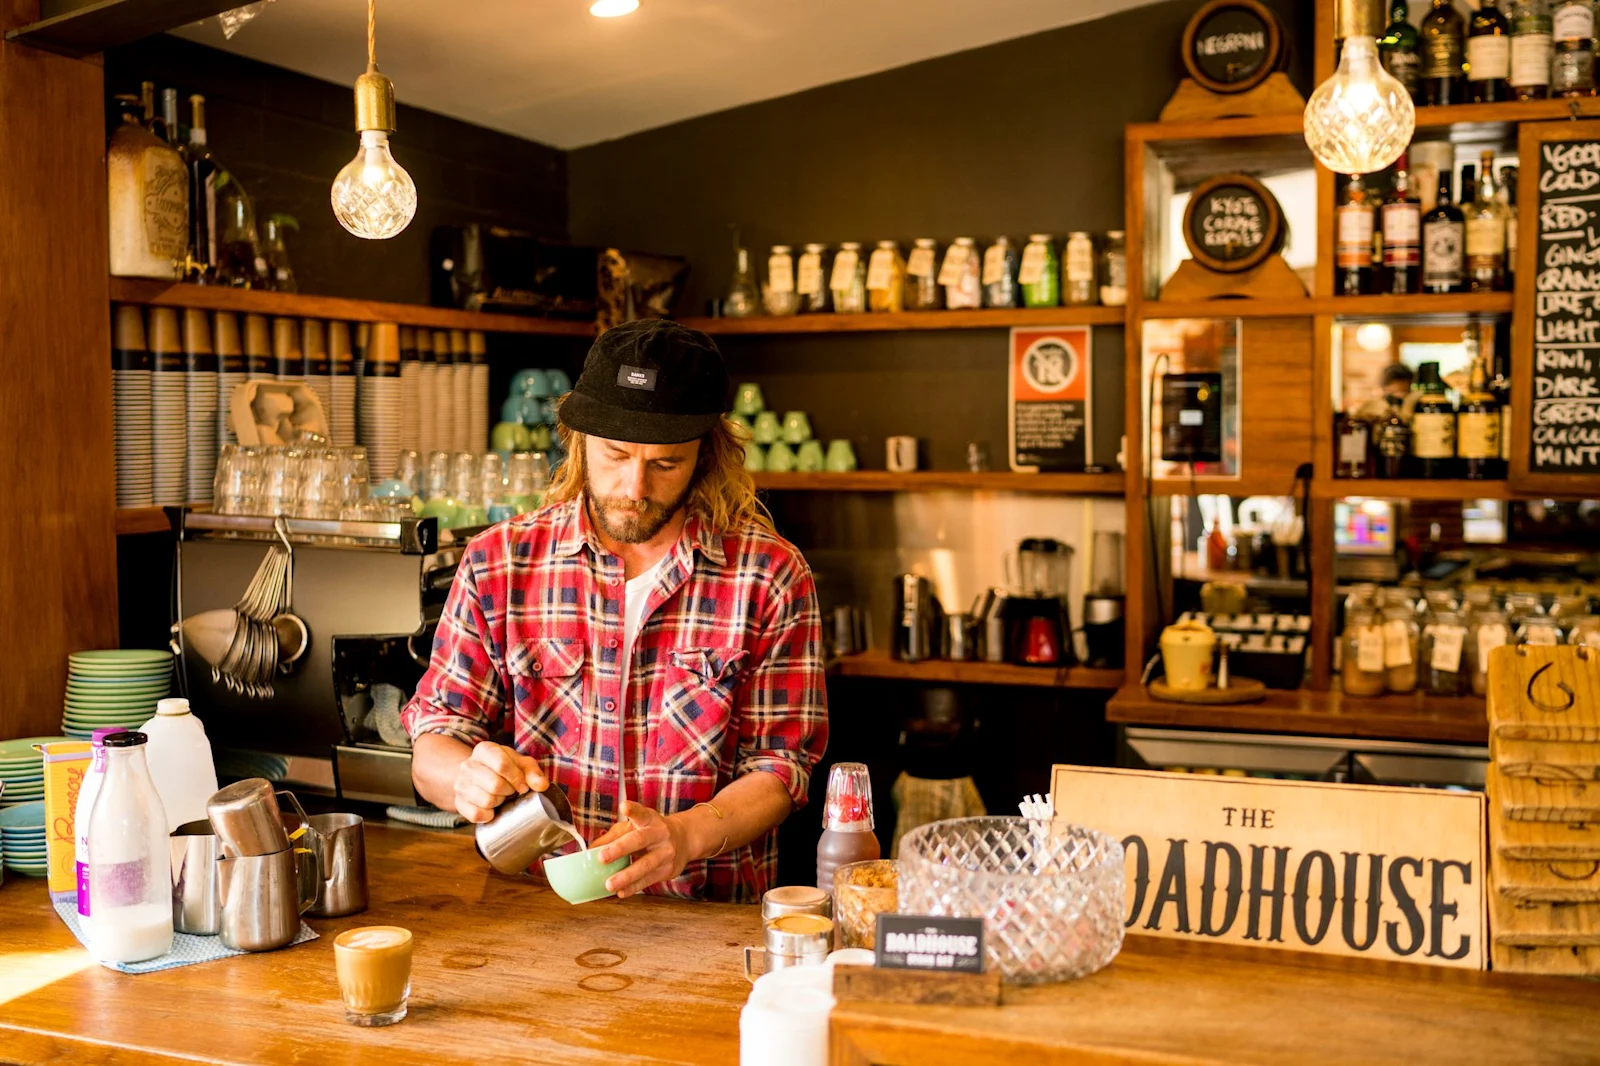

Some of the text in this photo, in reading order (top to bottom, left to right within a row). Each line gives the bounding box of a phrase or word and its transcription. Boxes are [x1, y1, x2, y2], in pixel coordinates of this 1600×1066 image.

[1222, 806, 1275, 829] THE
[1120, 834, 1472, 961] OADHOUSE
[885, 932, 978, 957] ROADHOUSE
